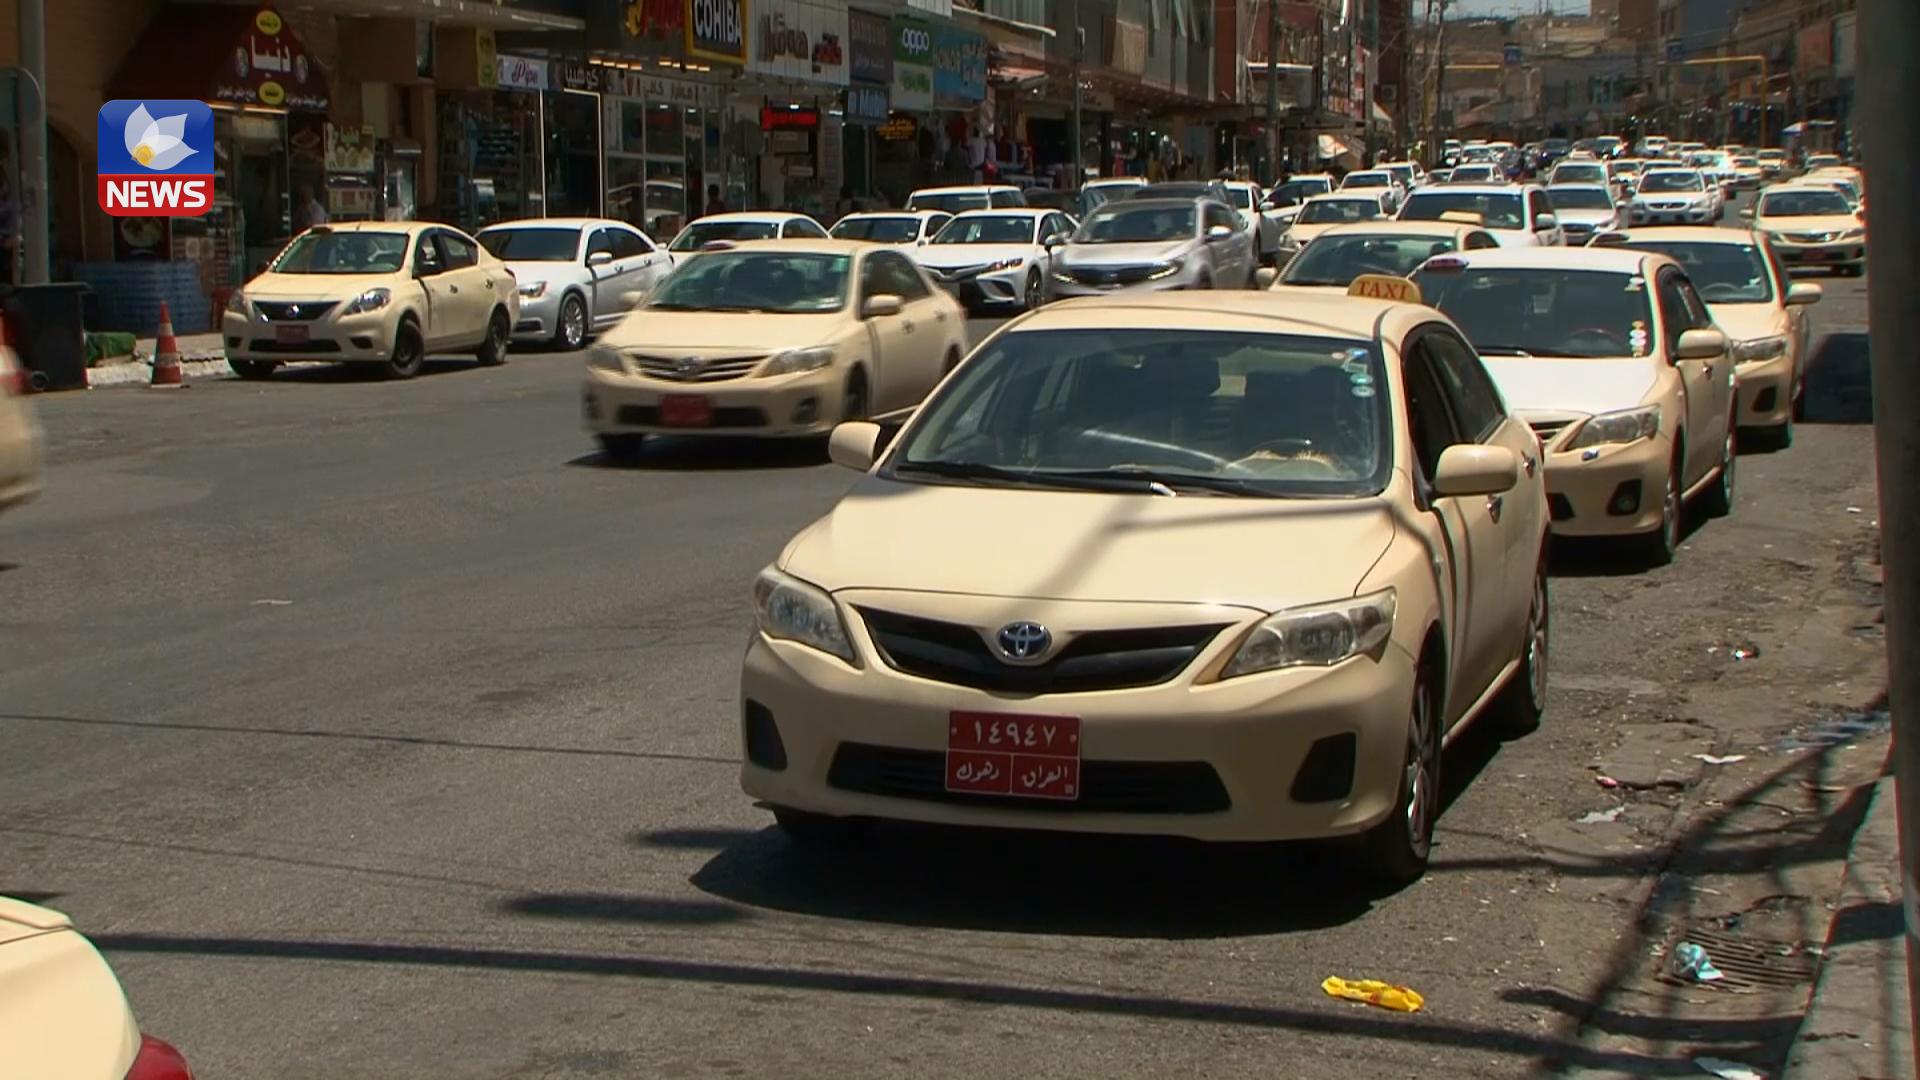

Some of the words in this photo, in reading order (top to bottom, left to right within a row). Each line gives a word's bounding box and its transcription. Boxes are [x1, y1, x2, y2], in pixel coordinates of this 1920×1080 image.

[694, 0, 743, 48] COHIBA
[902, 27, 929, 55] oppo
[1358, 280, 1407, 300] TAXI
[974, 719, 1056, 747] ١٤٩٤٧
[956, 760, 999, 783] دهوك
[1021, 764, 1068, 789] العراق
